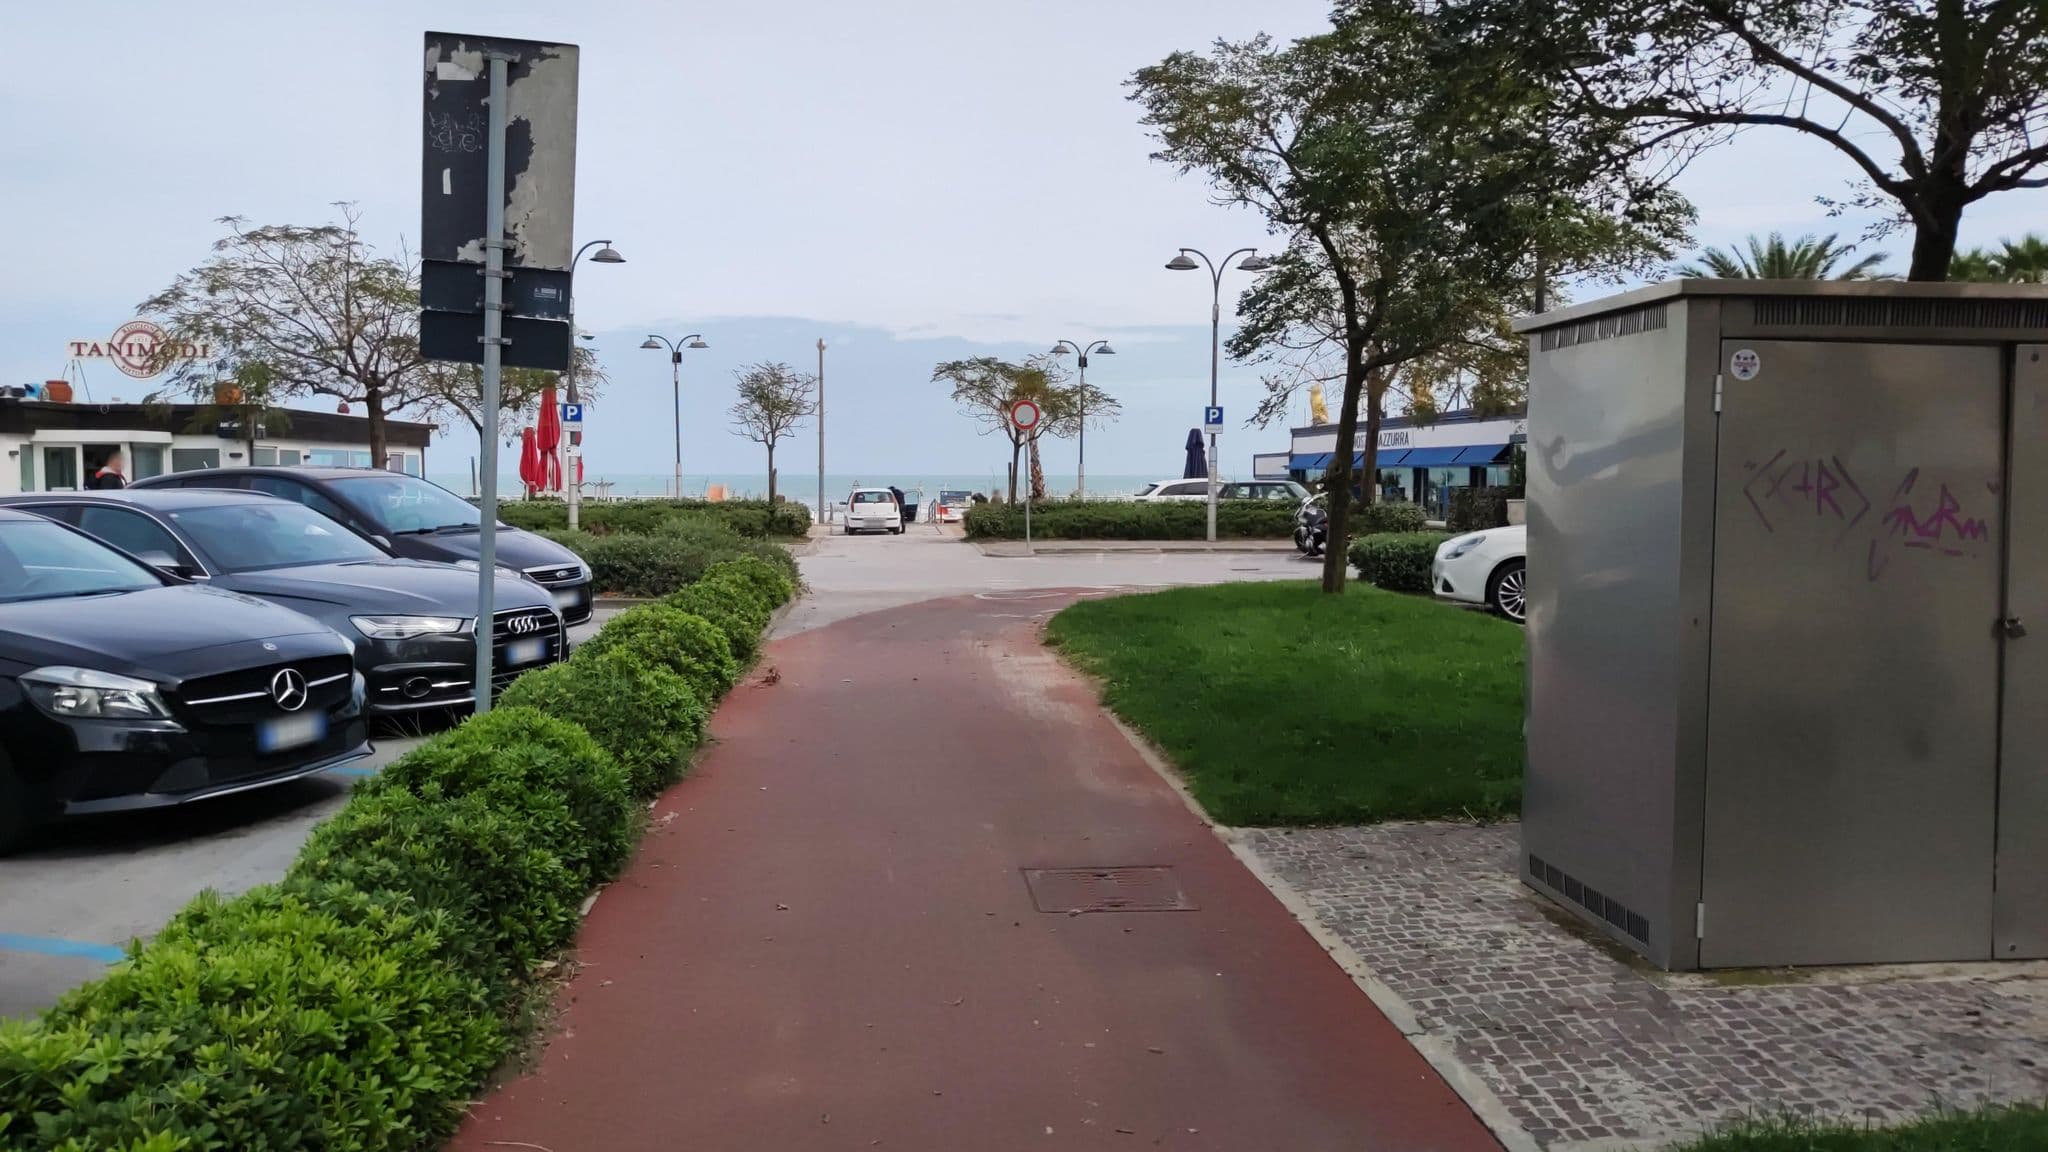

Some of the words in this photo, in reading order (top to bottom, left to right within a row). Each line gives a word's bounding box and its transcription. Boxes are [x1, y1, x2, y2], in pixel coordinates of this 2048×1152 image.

[566, 405, 578, 420] P
[1209, 409, 1220, 423] P
[1378, 431, 1409, 447] AZZURRA
